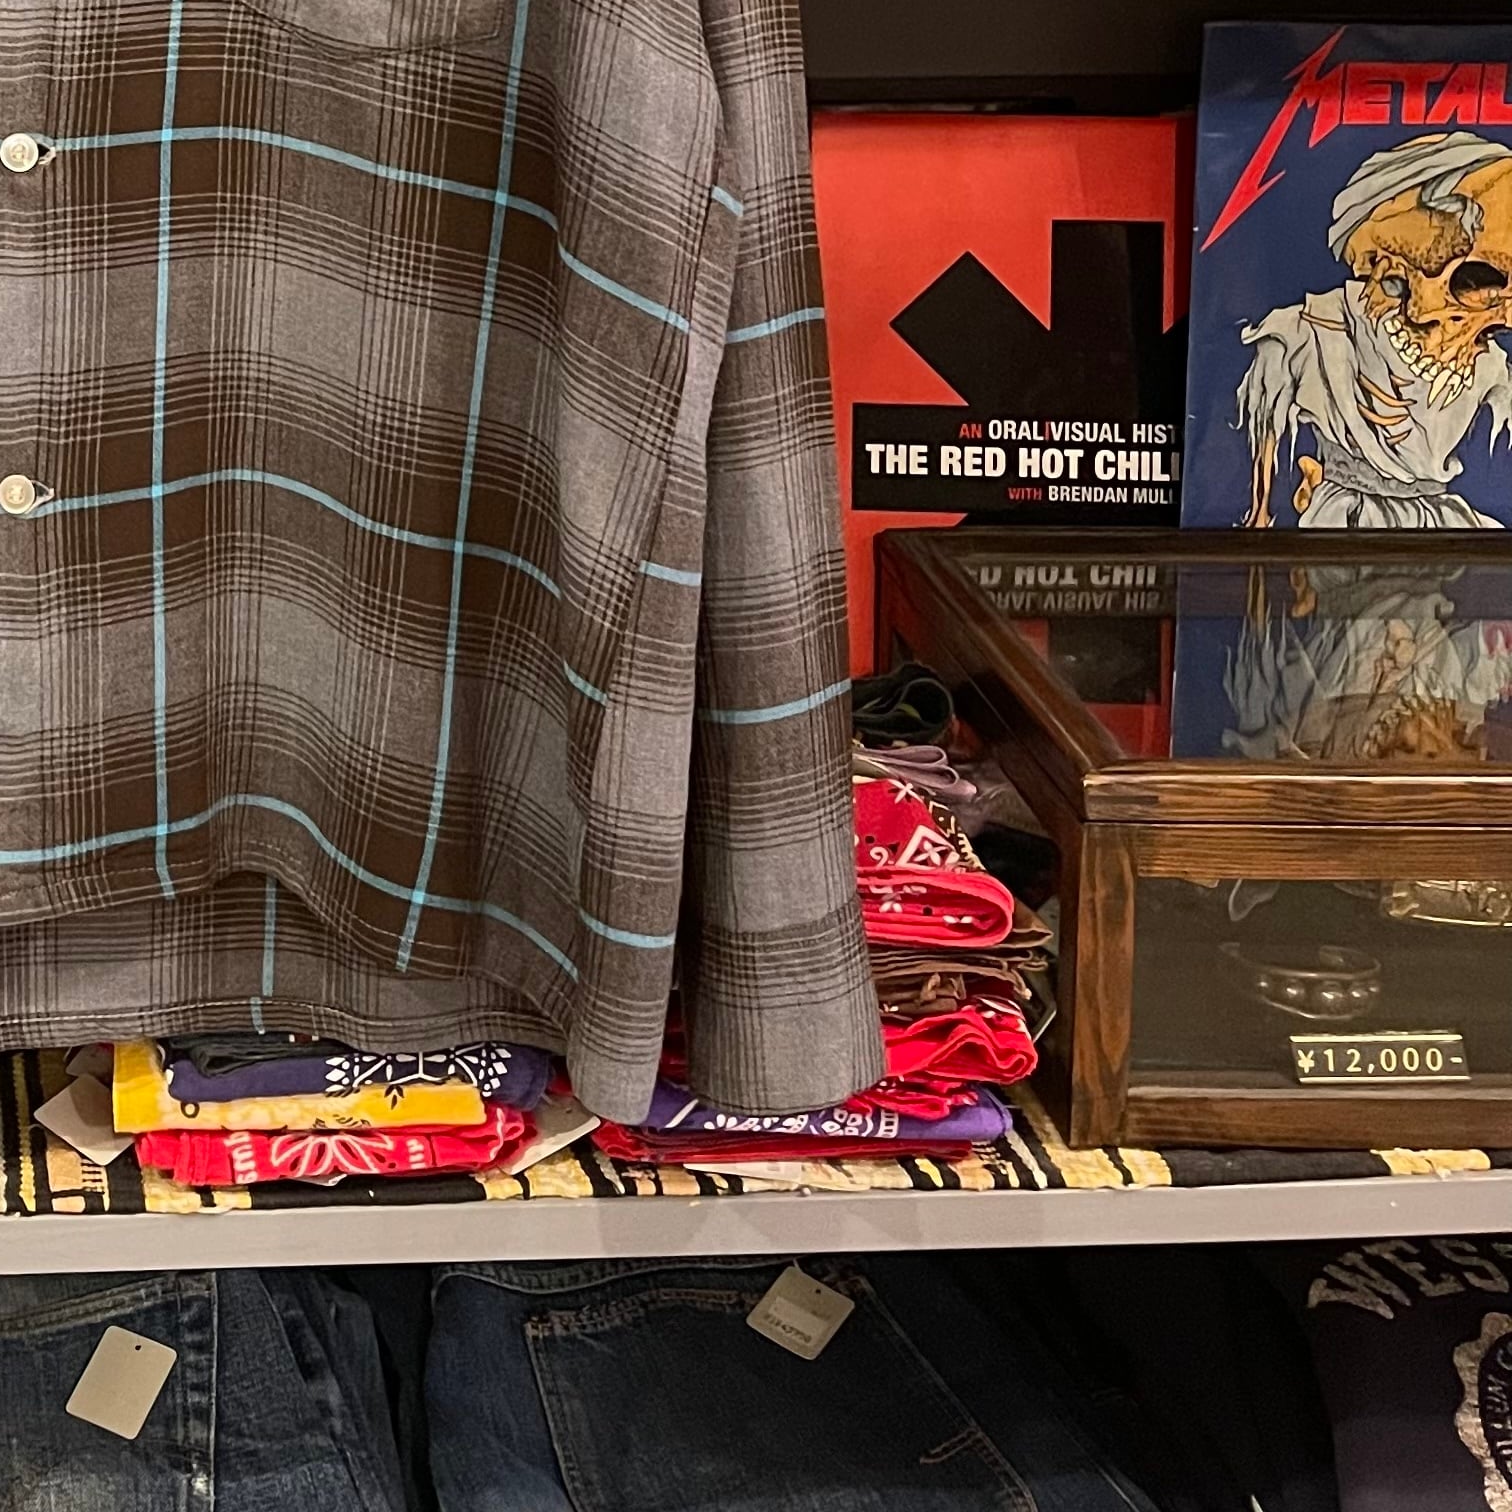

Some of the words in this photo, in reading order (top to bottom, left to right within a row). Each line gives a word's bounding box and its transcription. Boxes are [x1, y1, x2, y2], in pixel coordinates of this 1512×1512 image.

[959, 423, 982, 438] AN
[865, 443, 928, 475] THE
[940, 445, 1006, 477] RED
[1018, 447, 1084, 479] HOT
[1008, 487, 1042, 501] WITH
[1048, 485, 1127, 503] BRENDAN
